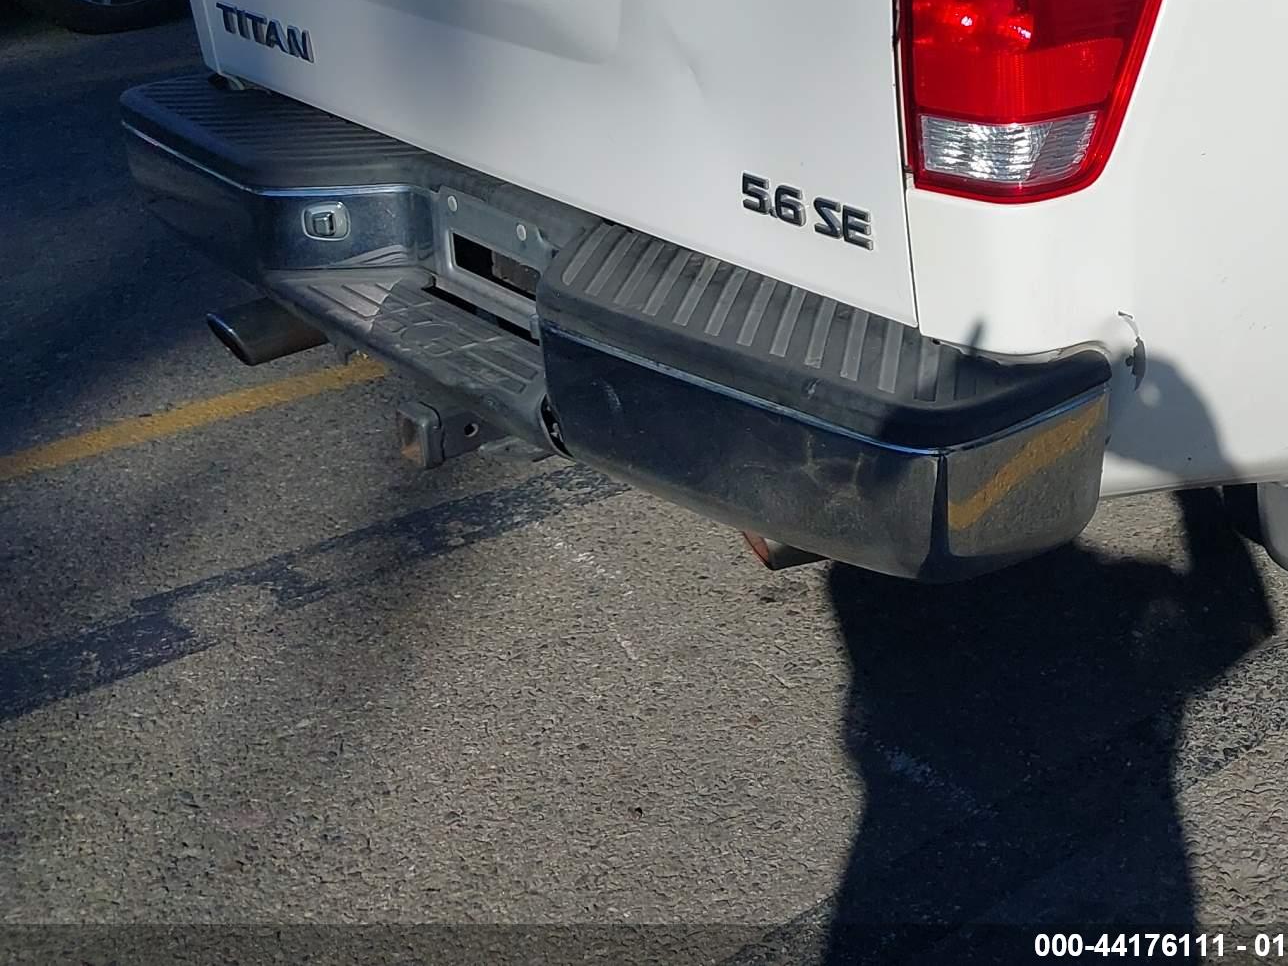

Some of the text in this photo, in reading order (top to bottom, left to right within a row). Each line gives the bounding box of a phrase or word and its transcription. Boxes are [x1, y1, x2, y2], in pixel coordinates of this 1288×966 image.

[215, 1, 315, 64] TITAN
[741, 171, 874, 252] 5.6 SE
